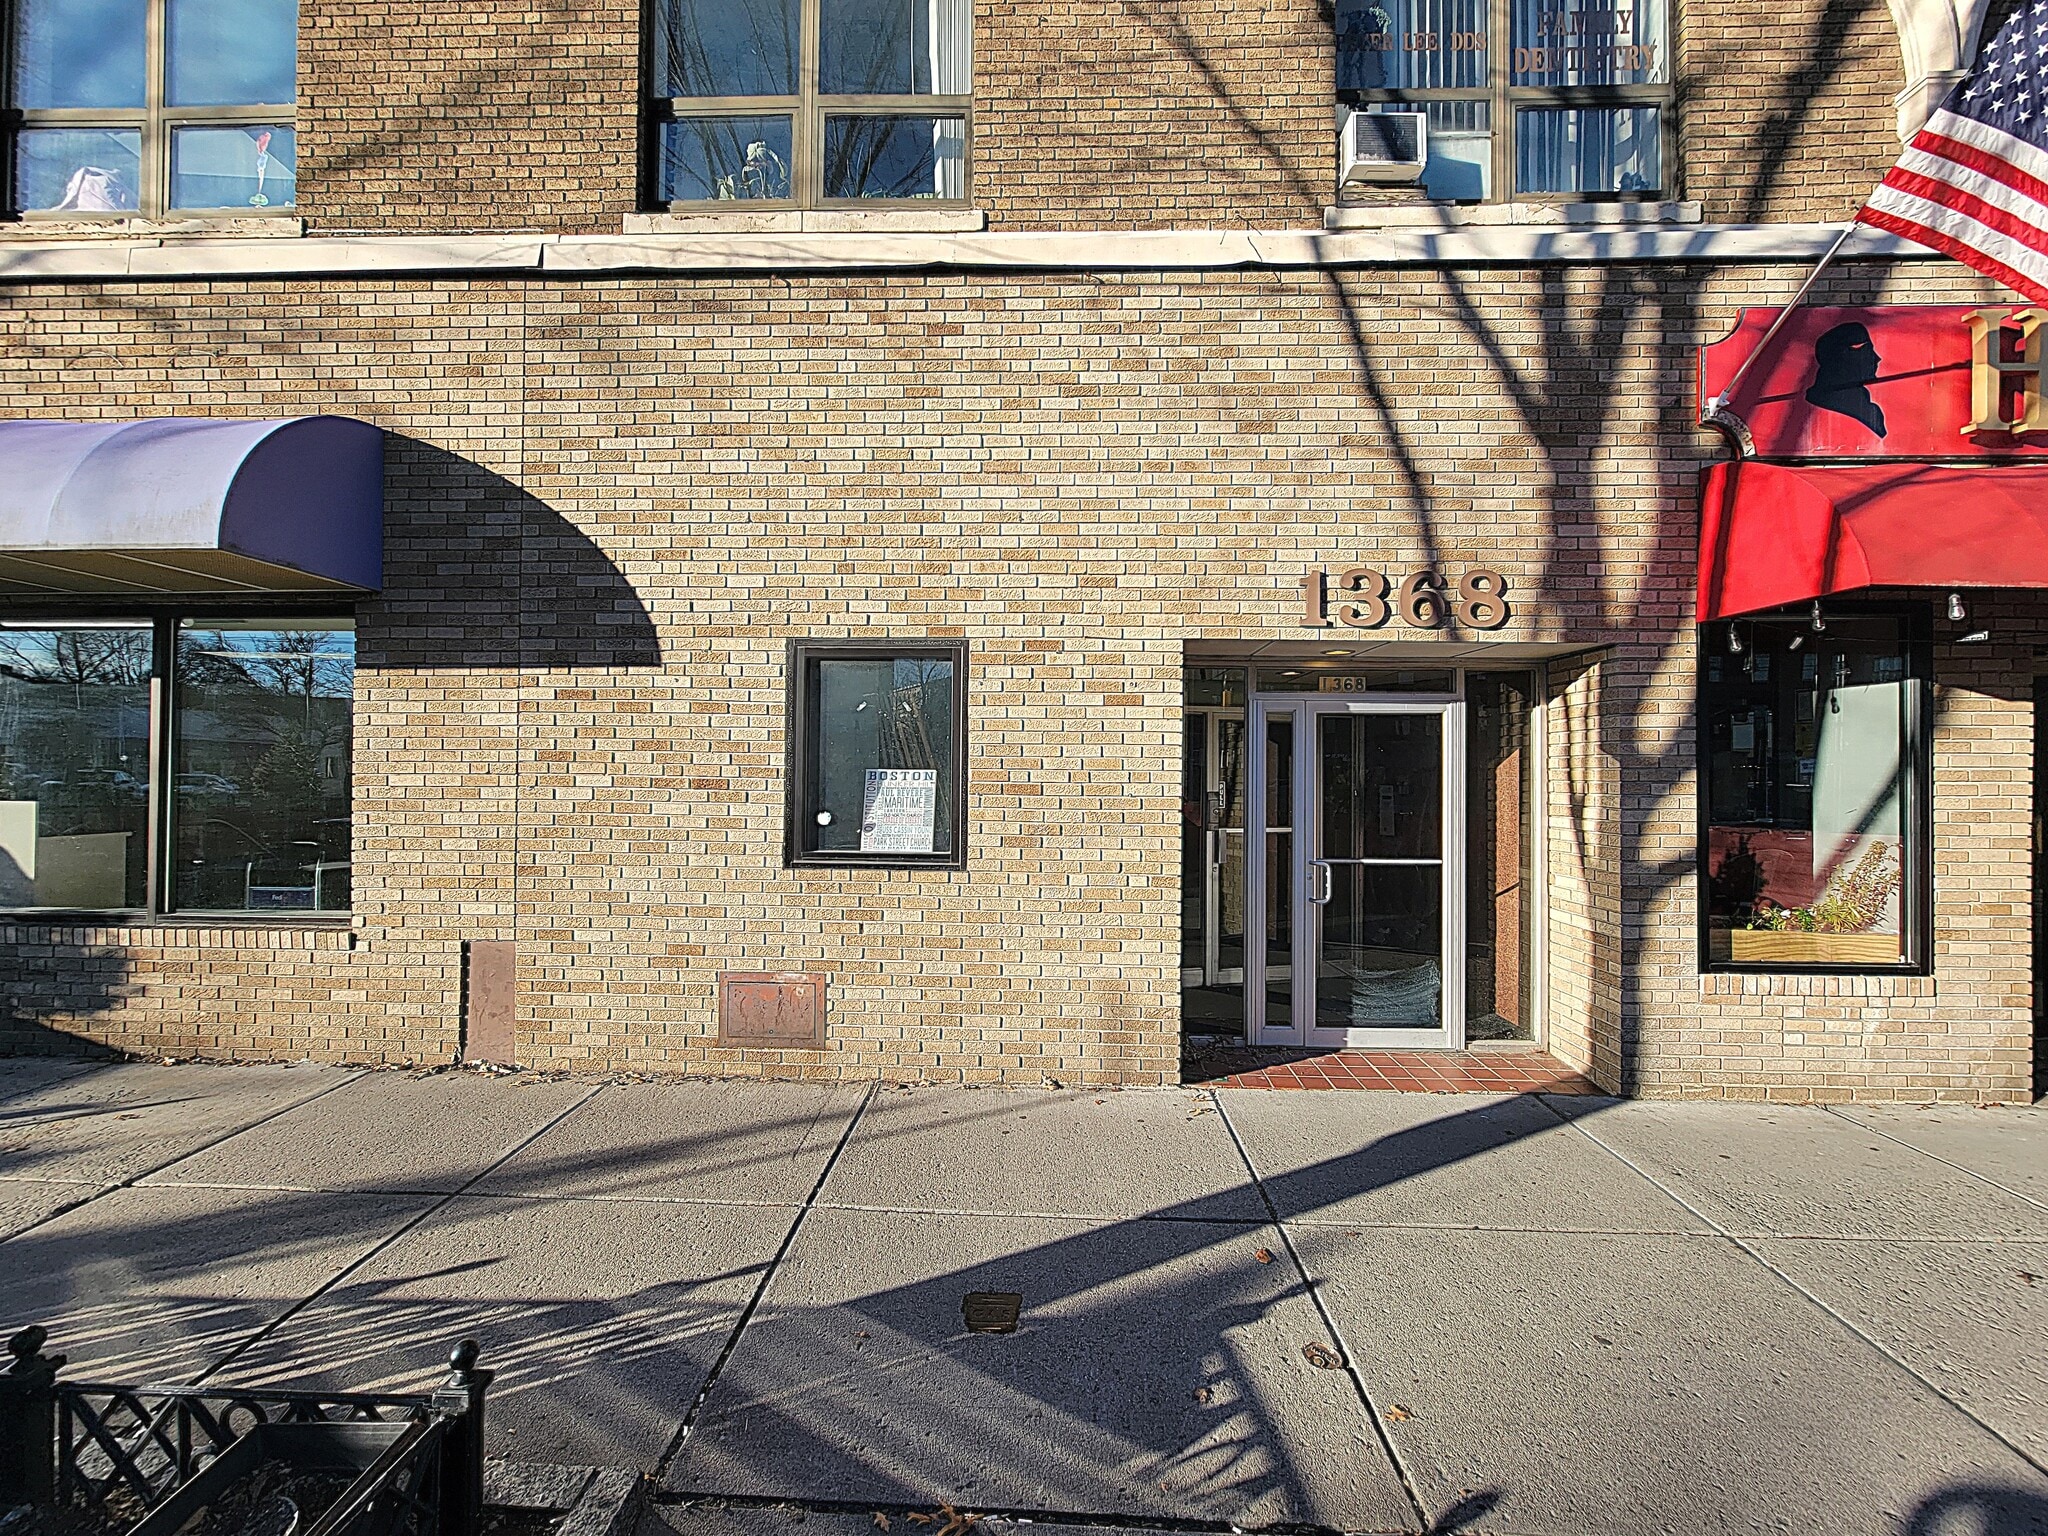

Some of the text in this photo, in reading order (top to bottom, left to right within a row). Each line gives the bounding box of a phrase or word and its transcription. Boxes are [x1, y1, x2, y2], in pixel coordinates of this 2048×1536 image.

[1536, 10, 1634, 36] FAMY
[1402, 32, 1438, 51] LEE
[1450, 32, 1487, 51] DDS
[1299, 568, 1507, 629] 1368
[1322, 677, 1364, 692] 1368
[867, 771, 934, 781] BOSTON
[863, 781, 877, 837] CONSTITUTION
[884, 796, 924, 808] MARITIME
